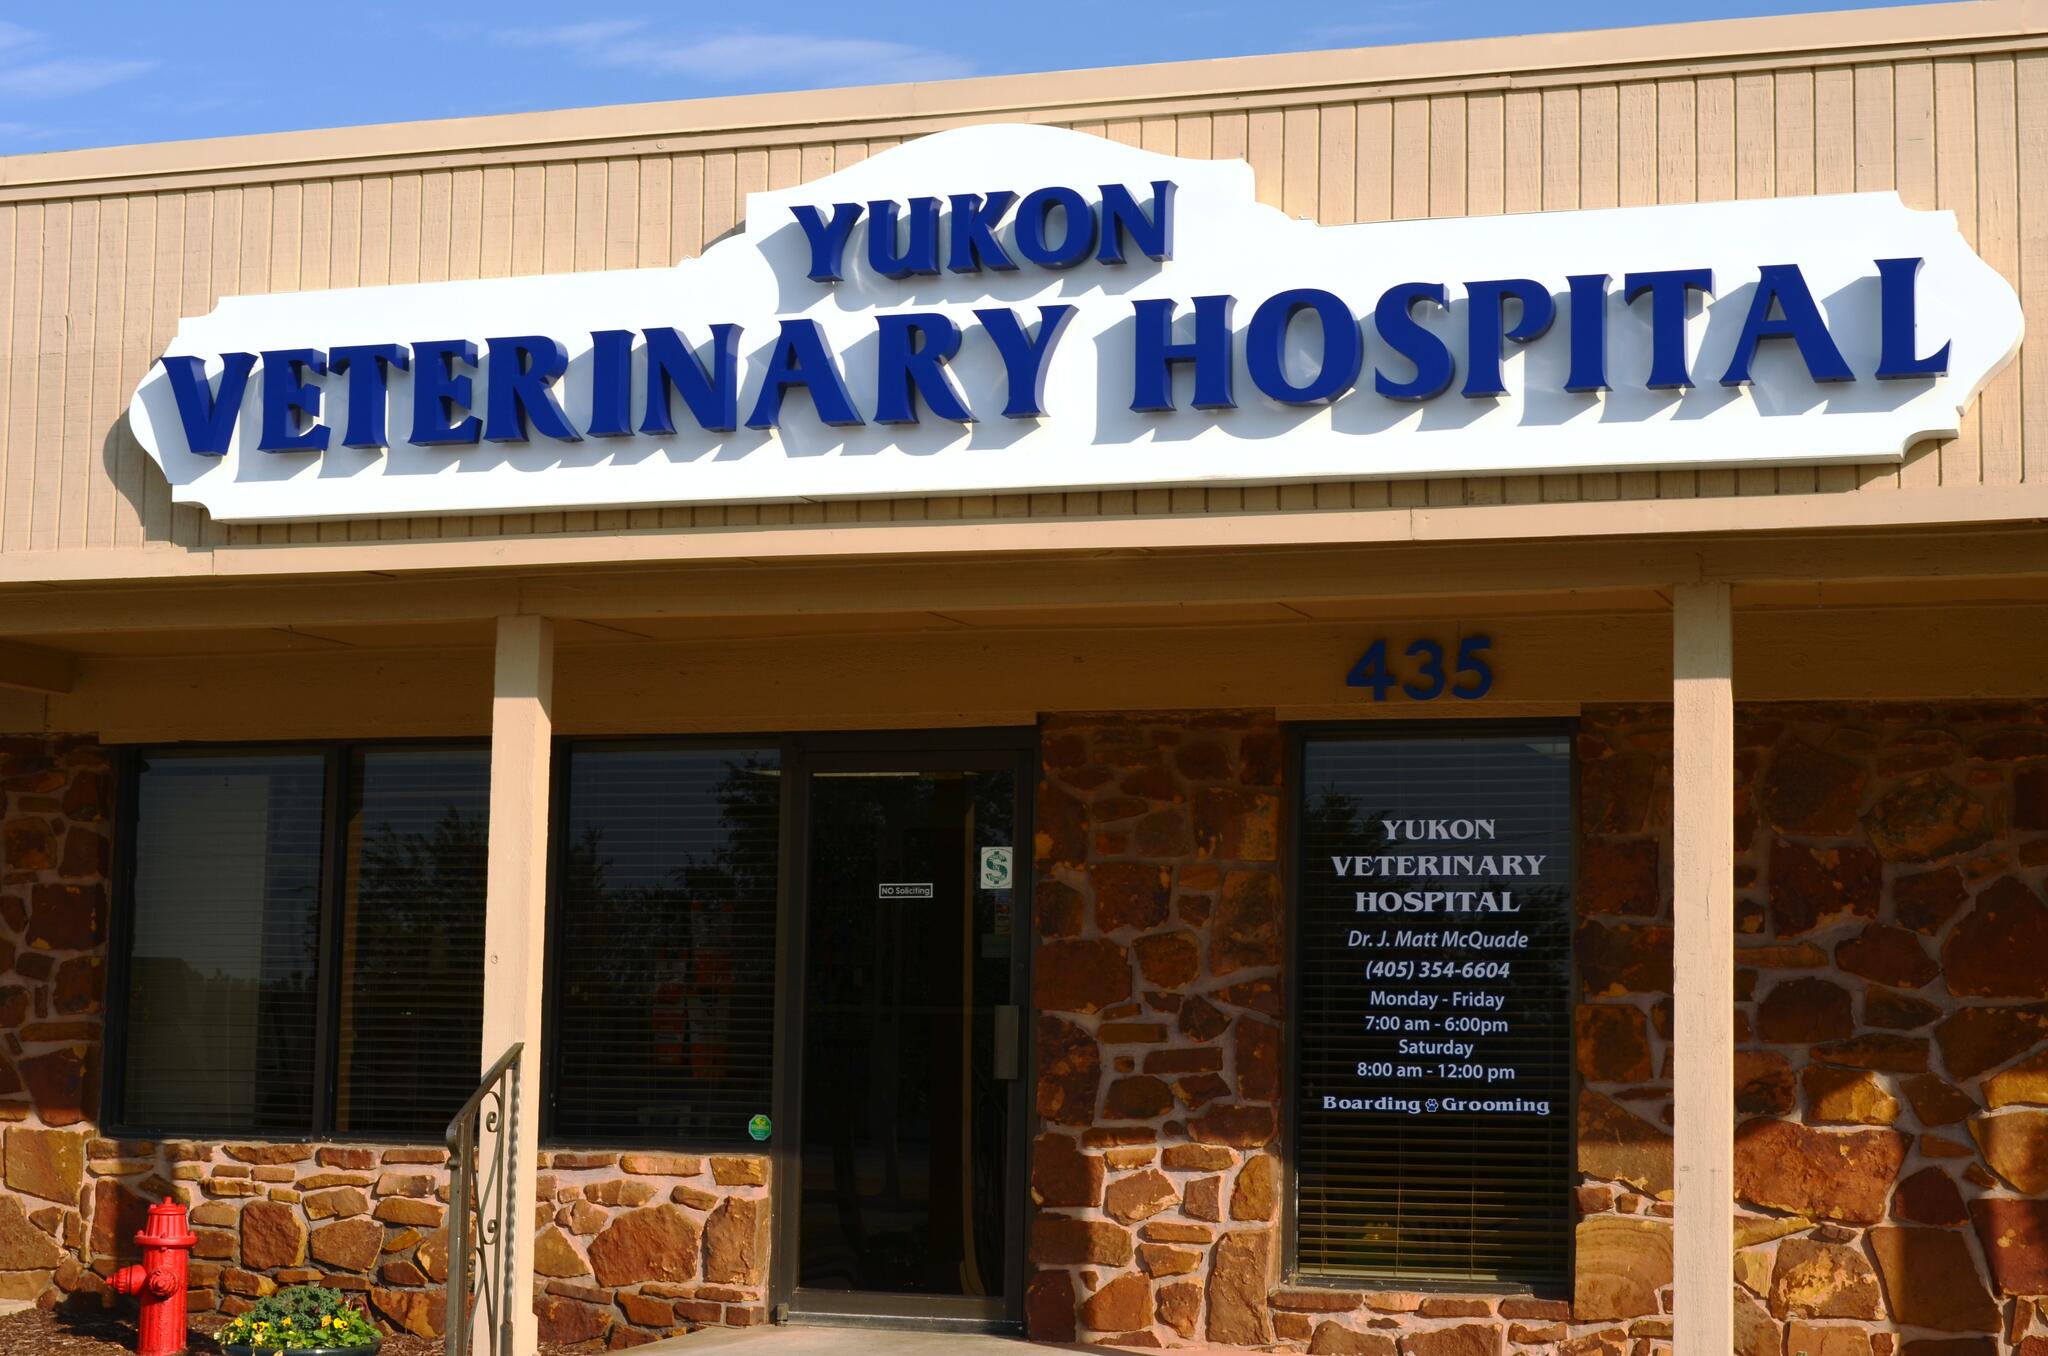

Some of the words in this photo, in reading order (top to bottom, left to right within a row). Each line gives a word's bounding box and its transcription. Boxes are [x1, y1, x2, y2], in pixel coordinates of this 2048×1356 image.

[789, 180, 1178, 283] YUKON
[160, 304, 1079, 457] VETERINARY
[1129, 257, 1953, 414] HOSPITAL
[1345, 638, 1494, 702] 435
[1381, 818, 1496, 841] YUKON
[1330, 854, 1547, 877] VETERINARY
[881, 887, 895, 895] NO
[895, 886, 931, 897] Soliciting
[1355, 891, 1521, 913] HOSPITAL
[1347, 930, 1373, 947] Dr.
[1377, 930, 1390, 947] J.
[1394, 930, 1438, 948] Matt
[1441, 930, 1529, 950] McQuade
[1365, 960, 1415, 980] (405)
[1418, 961, 1510, 979] 354-6604
[1370, 990, 1439, 1010] Monday
[1452, 991, 1505, 1012] Friday
[1365, 1015, 1401, 1031] 7:00
[1404, 1019, 1430, 1031] am
[1444, 1016, 1509, 1036] 6:00pm
[1398, 1038, 1474, 1060] Saturday
[1356, 1061, 1393, 1077] 8:00
[1396, 1065, 1423, 1078] am
[1438, 1063, 1484, 1079] 12:00
[1487, 1067, 1515, 1083] pm
[1323, 1095, 1422, 1115] Boarding
[1441, 1096, 1550, 1116] Grooming
